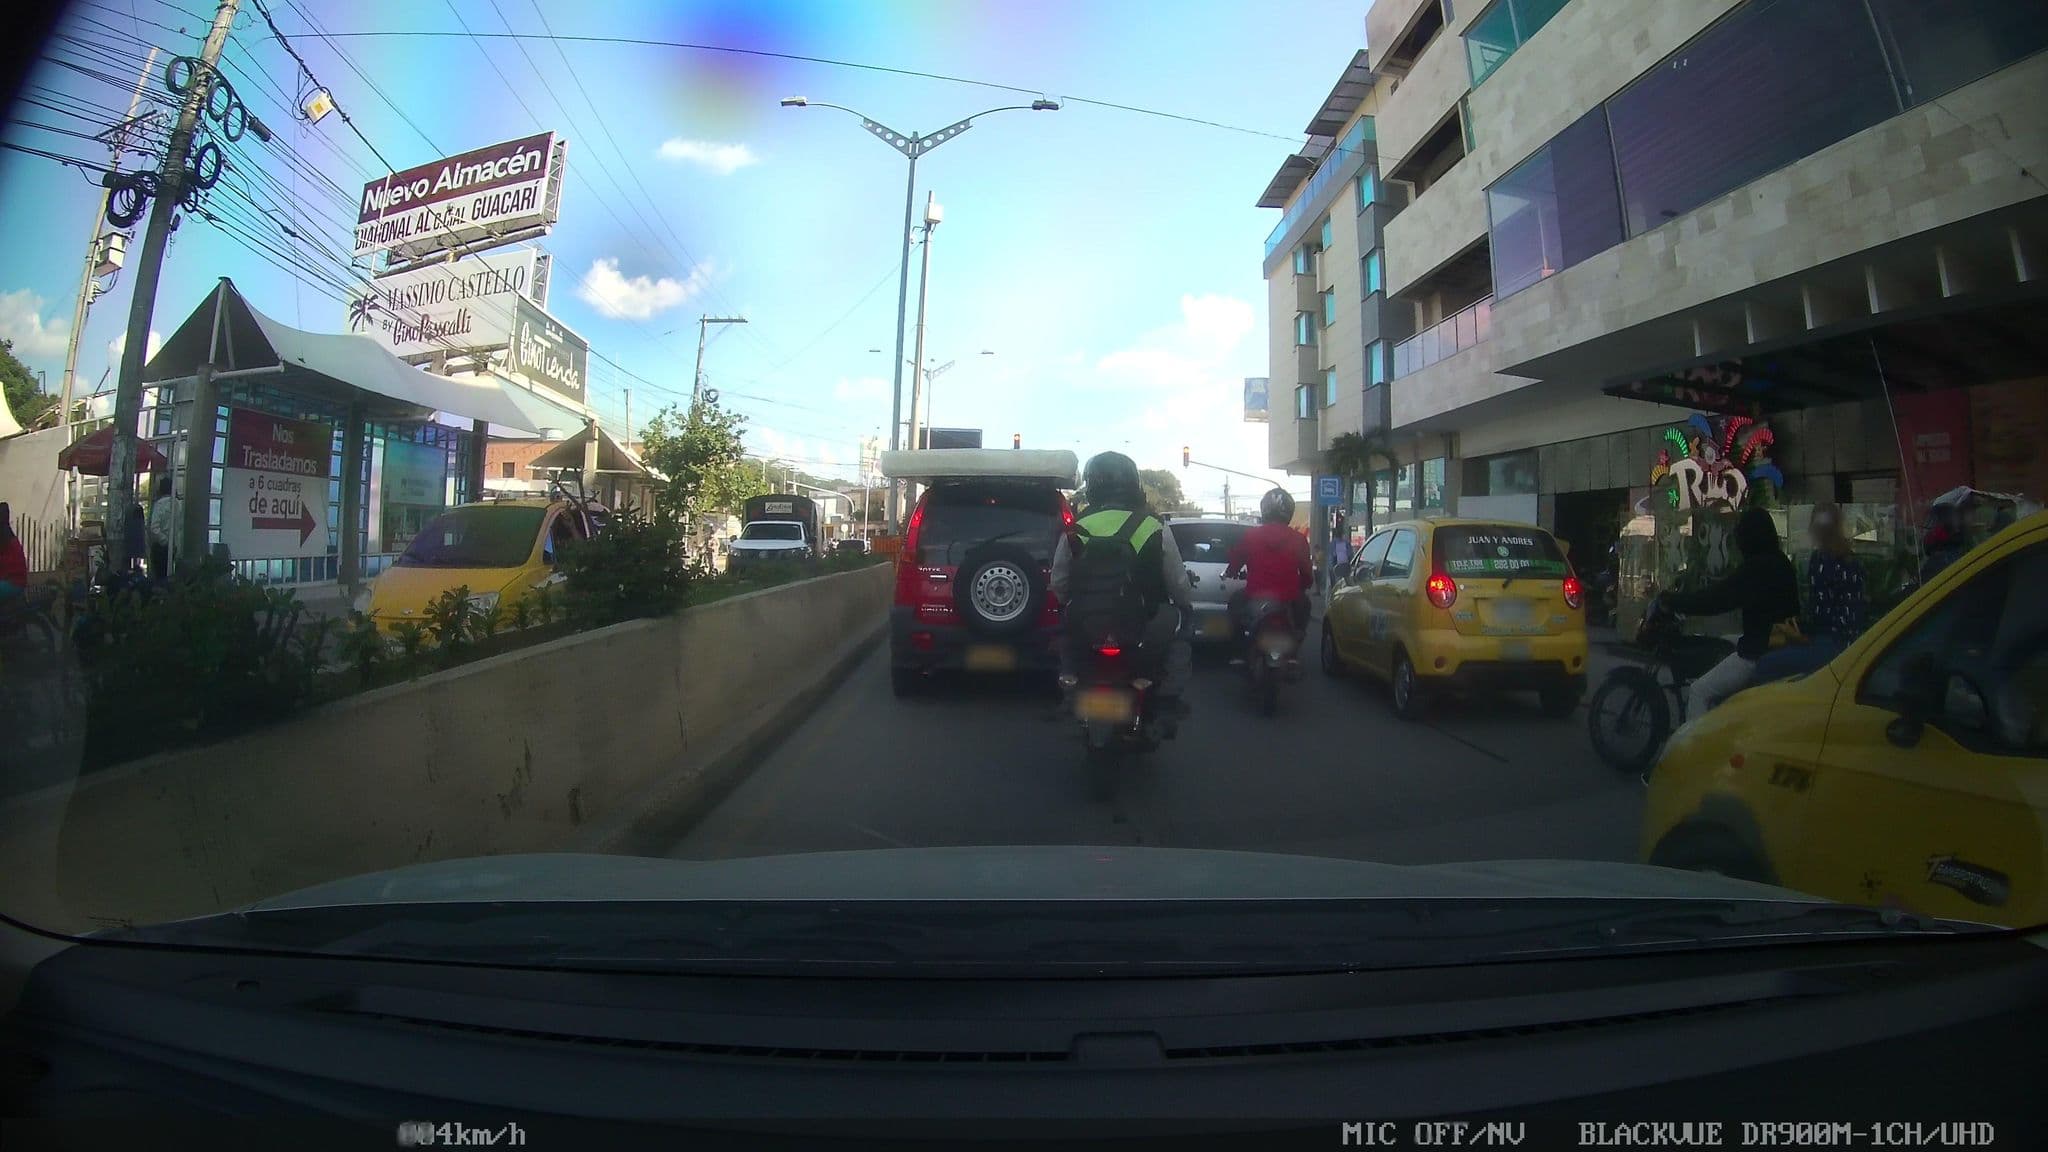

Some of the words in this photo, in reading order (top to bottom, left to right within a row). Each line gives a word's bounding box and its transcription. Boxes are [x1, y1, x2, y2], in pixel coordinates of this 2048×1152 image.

[363, 178, 430, 214] Nuevo
[431, 146, 541, 195] Almacén
[414, 211, 431, 235] AL
[471, 180, 541, 221] GUACARÍ
[387, 279, 446, 311] MASSIMO
[447, 265, 526, 302] CASTELLO
[382, 319, 393, 332] BY
[272, 423, 295, 444] Nos
[242, 444, 318, 474] Trasladamos
[248, 477, 255, 489] a
[257, 475, 265, 490] 6
[266, 477, 302, 493] cuadras
[248, 491, 268, 514] de
[271, 494, 301, 518] aquí
[1467, 535, 1491, 545] JUAN
[1491, 536, 1499, 545] Y
[1501, 536, 1534, 547] ANDRES
